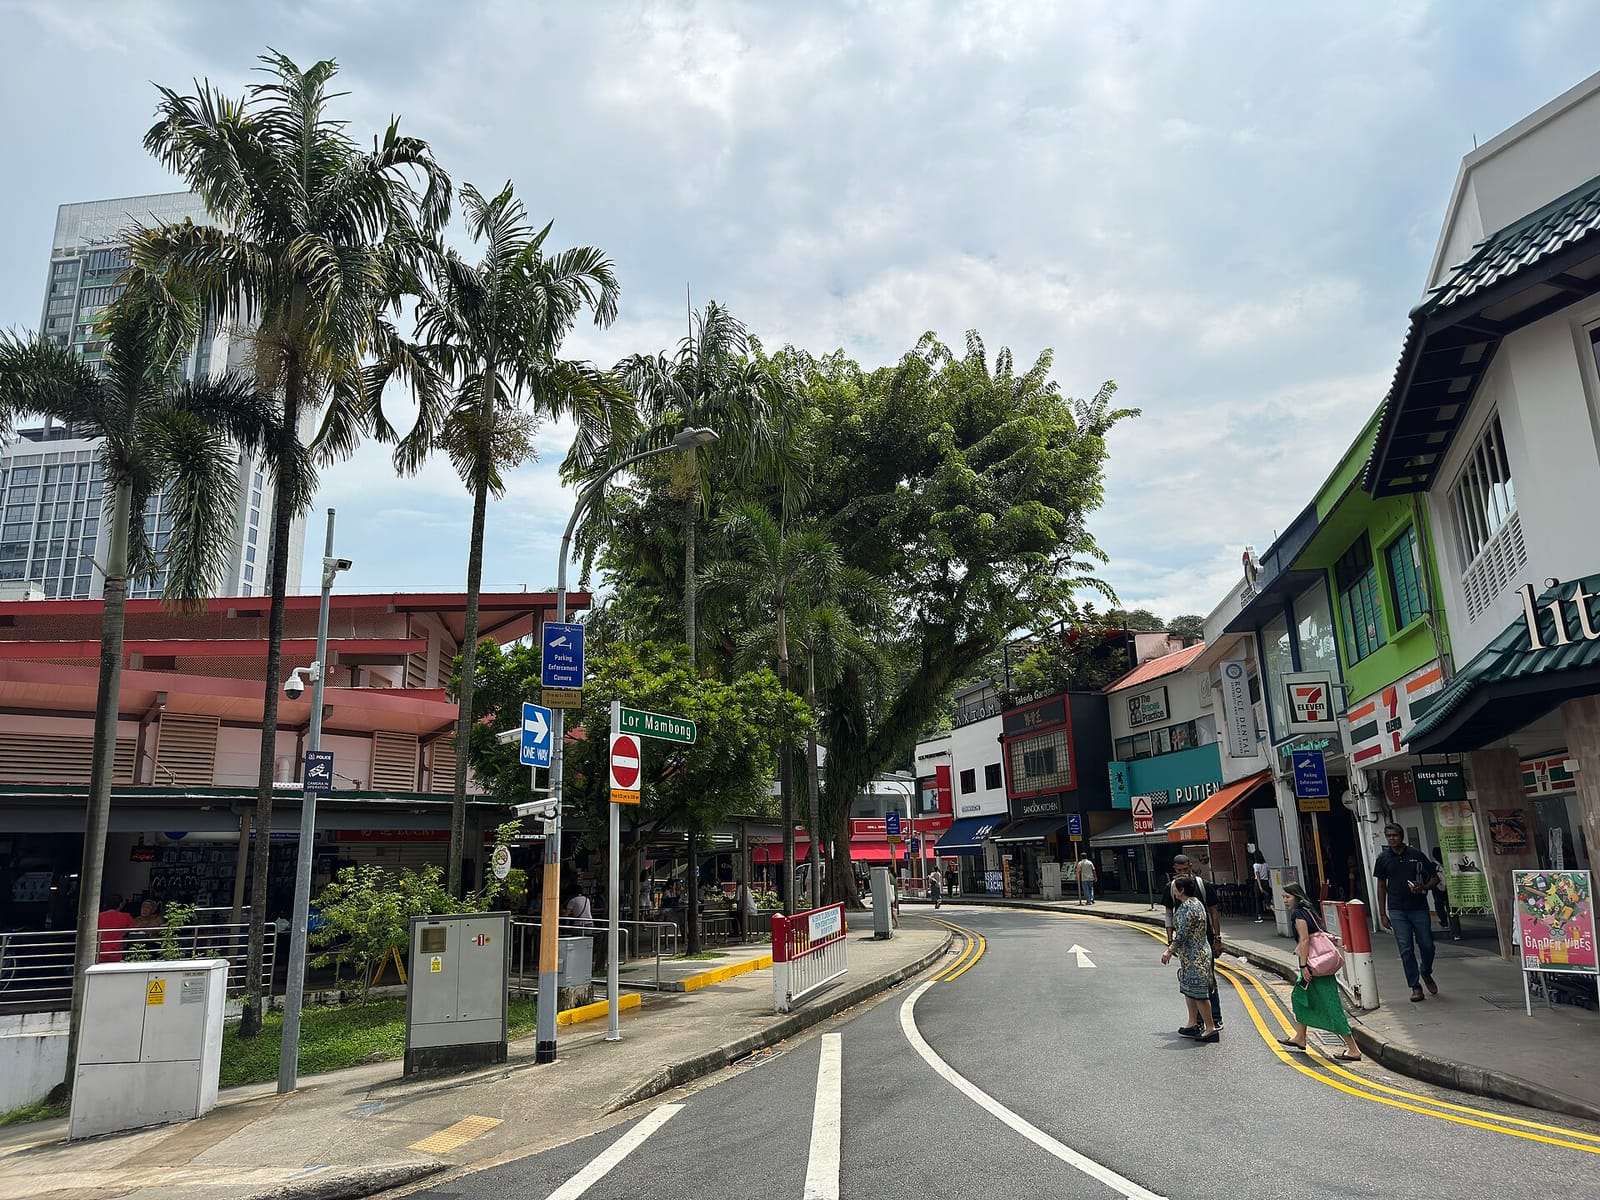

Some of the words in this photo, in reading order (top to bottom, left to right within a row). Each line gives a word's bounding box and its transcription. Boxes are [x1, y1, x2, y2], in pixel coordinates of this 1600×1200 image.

[554, 654, 573, 663] Parking
[548, 663, 578, 672] Enforcement
[553, 674, 572, 682] Camera
[1014, 693, 1034, 707] Takeda
[1033, 687, 1055, 700] Garden
[1141, 694, 1151, 704] The
[1234, 681, 1245, 711] ROYCE
[1296, 687, 1323, 722] 7
[956, 704, 995, 726] AXIOM
[1142, 709, 1165, 722] Practice
[622, 710, 640, 728] Lor
[644, 715, 691, 740] Mambong
[1239, 716, 1250, 754] DENTAL
[523, 745, 536, 760] ONE
[536, 747, 549, 762] WAY
[1417, 772, 1436, 780] little
[1436, 770, 1459, 778] farms
[1429, 778, 1449, 786] table
[1175, 781, 1220, 803] PUTIEN
[1040, 801, 1058, 812] KITCHEN
[1134, 820, 1153, 830] SLOW
[1524, 935, 1562, 951] GARDEN
